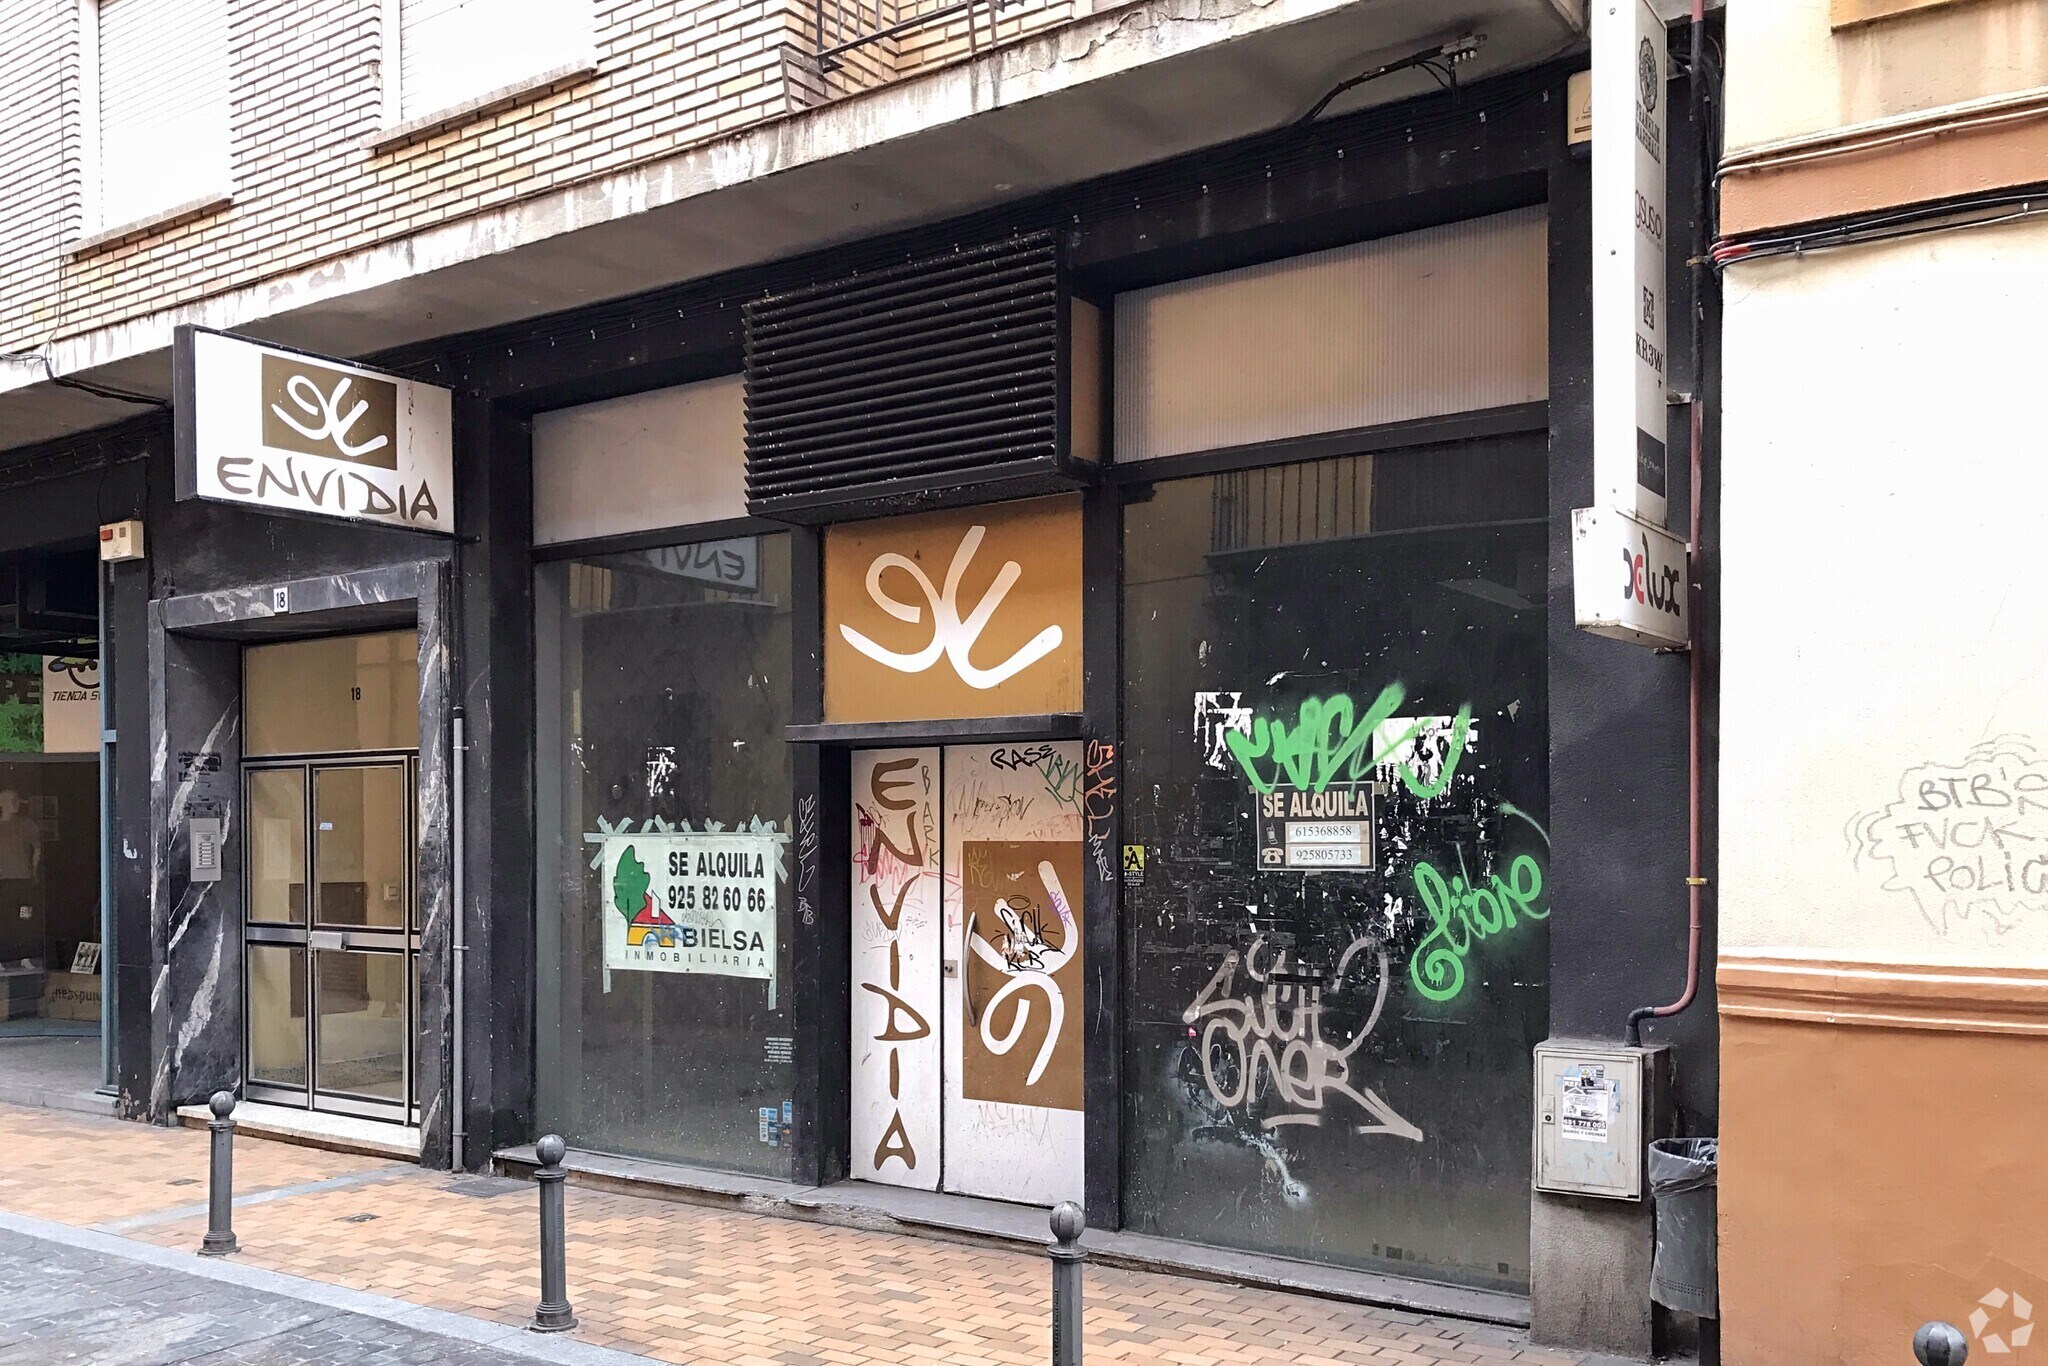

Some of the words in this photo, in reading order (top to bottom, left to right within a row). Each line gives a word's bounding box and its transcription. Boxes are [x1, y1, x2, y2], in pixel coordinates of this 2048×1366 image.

[1635, 332, 1664, 374] KR3W
[217, 456, 438, 521] ENVIDIA
[276, 591, 286, 608] 18
[52, 691, 87, 701] TIENDA
[351, 687, 361, 701] 18
[1262, 792, 1285, 818] SE
[1290, 791, 1369, 819] ALQUILA
[1295, 825, 1352, 837] 615368858
[668, 851, 689, 876] SE
[696, 852, 765, 878] ALQUILA
[1296, 850, 1353, 860] 925805733
[668, 885, 695, 909] 925
[702, 886, 719, 910] 82
[723, 886, 741, 911] 60
[748, 887, 766, 912] 66
[682, 928, 765, 951] BIELSA
[625, 950, 765, 967] INMOBILIARIA
[862, 757, 930, 1171] ENVIDIA
